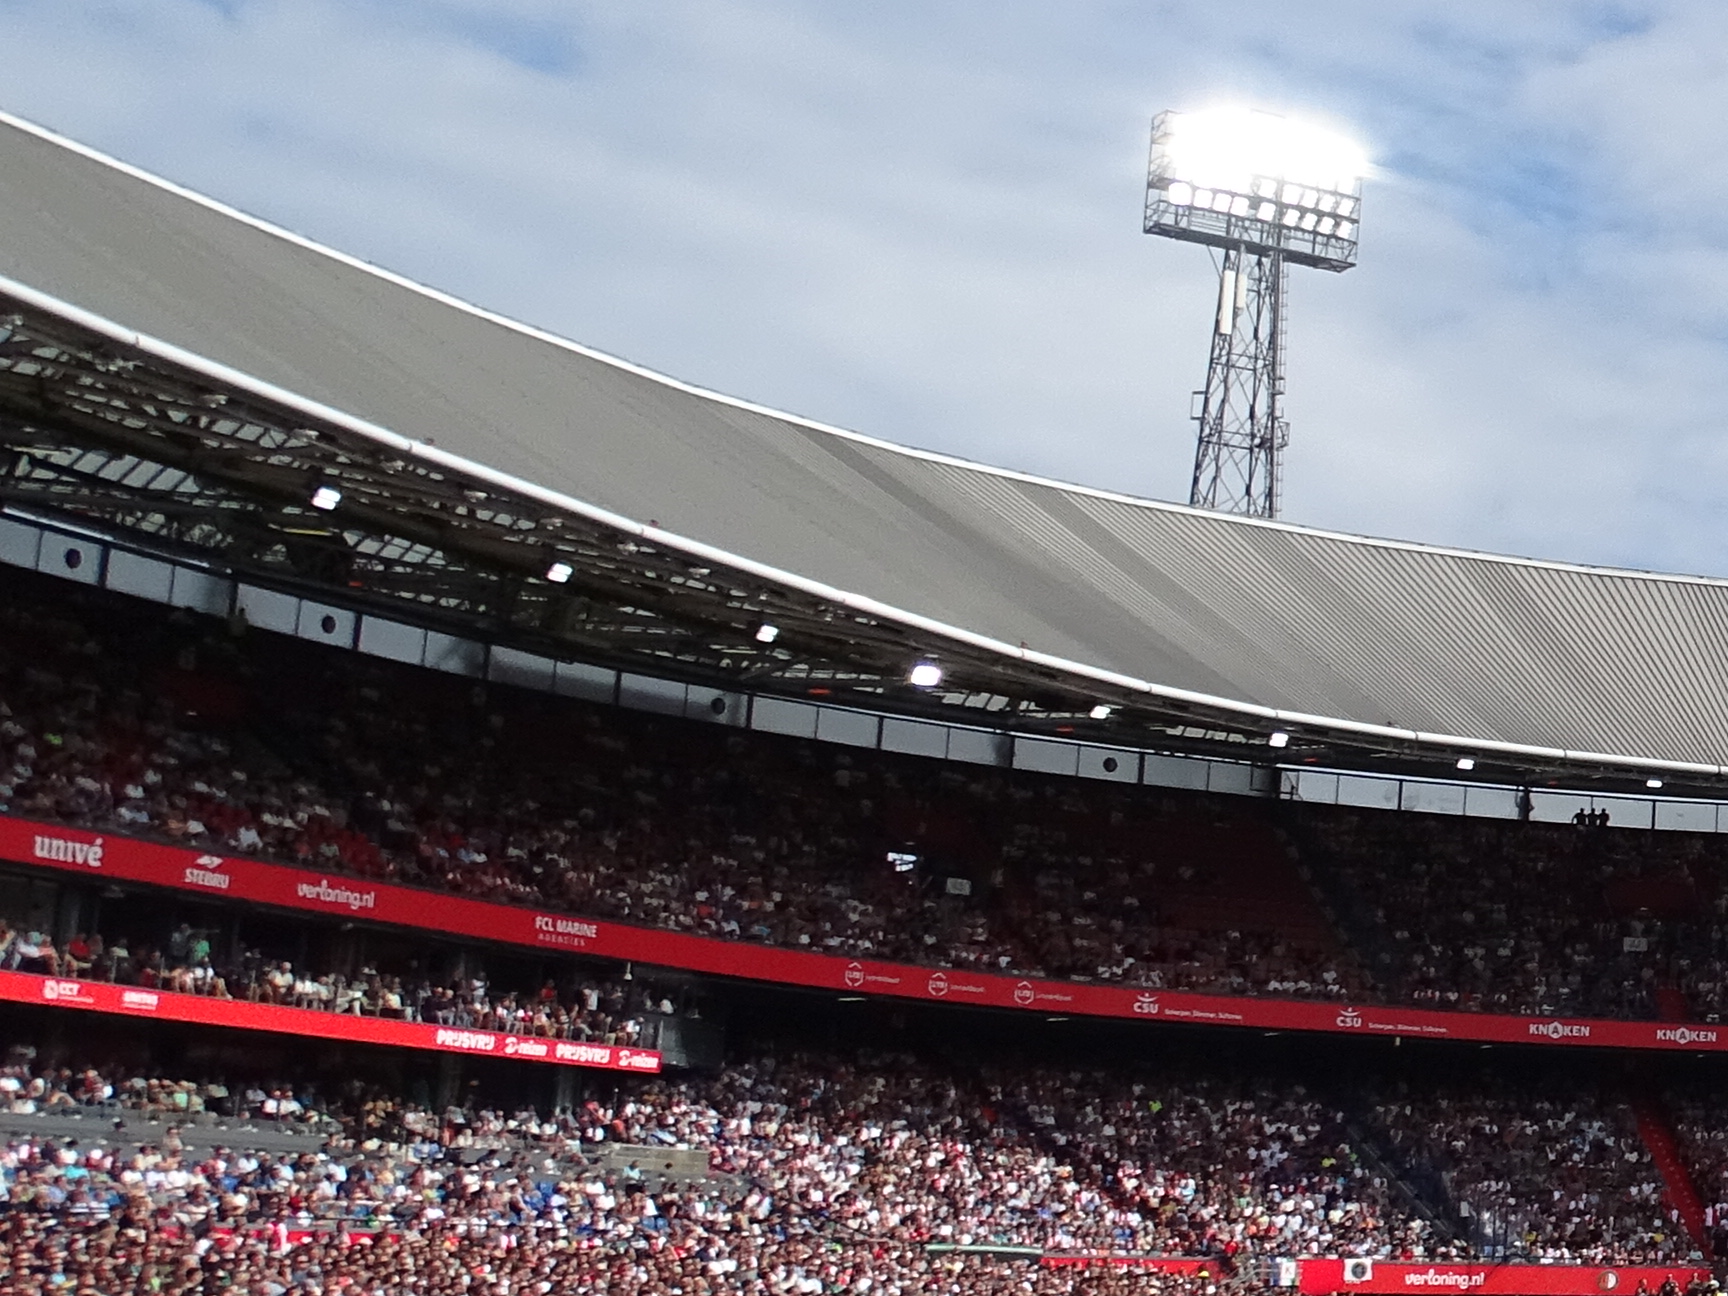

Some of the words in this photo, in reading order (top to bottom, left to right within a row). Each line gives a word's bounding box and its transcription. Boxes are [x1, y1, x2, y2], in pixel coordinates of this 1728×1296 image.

[34, 835, 103, 866] univé
[535, 915, 554, 931] FCL
[1133, 1002, 1159, 1014] CSU
[1336, 1015, 1361, 1028] CSU
[1529, 1022, 1590, 1039] KNAKEN
[1656, 1027, 1717, 1044] KNAKEN
[1405, 1269, 1484, 1289] verloning.nl
